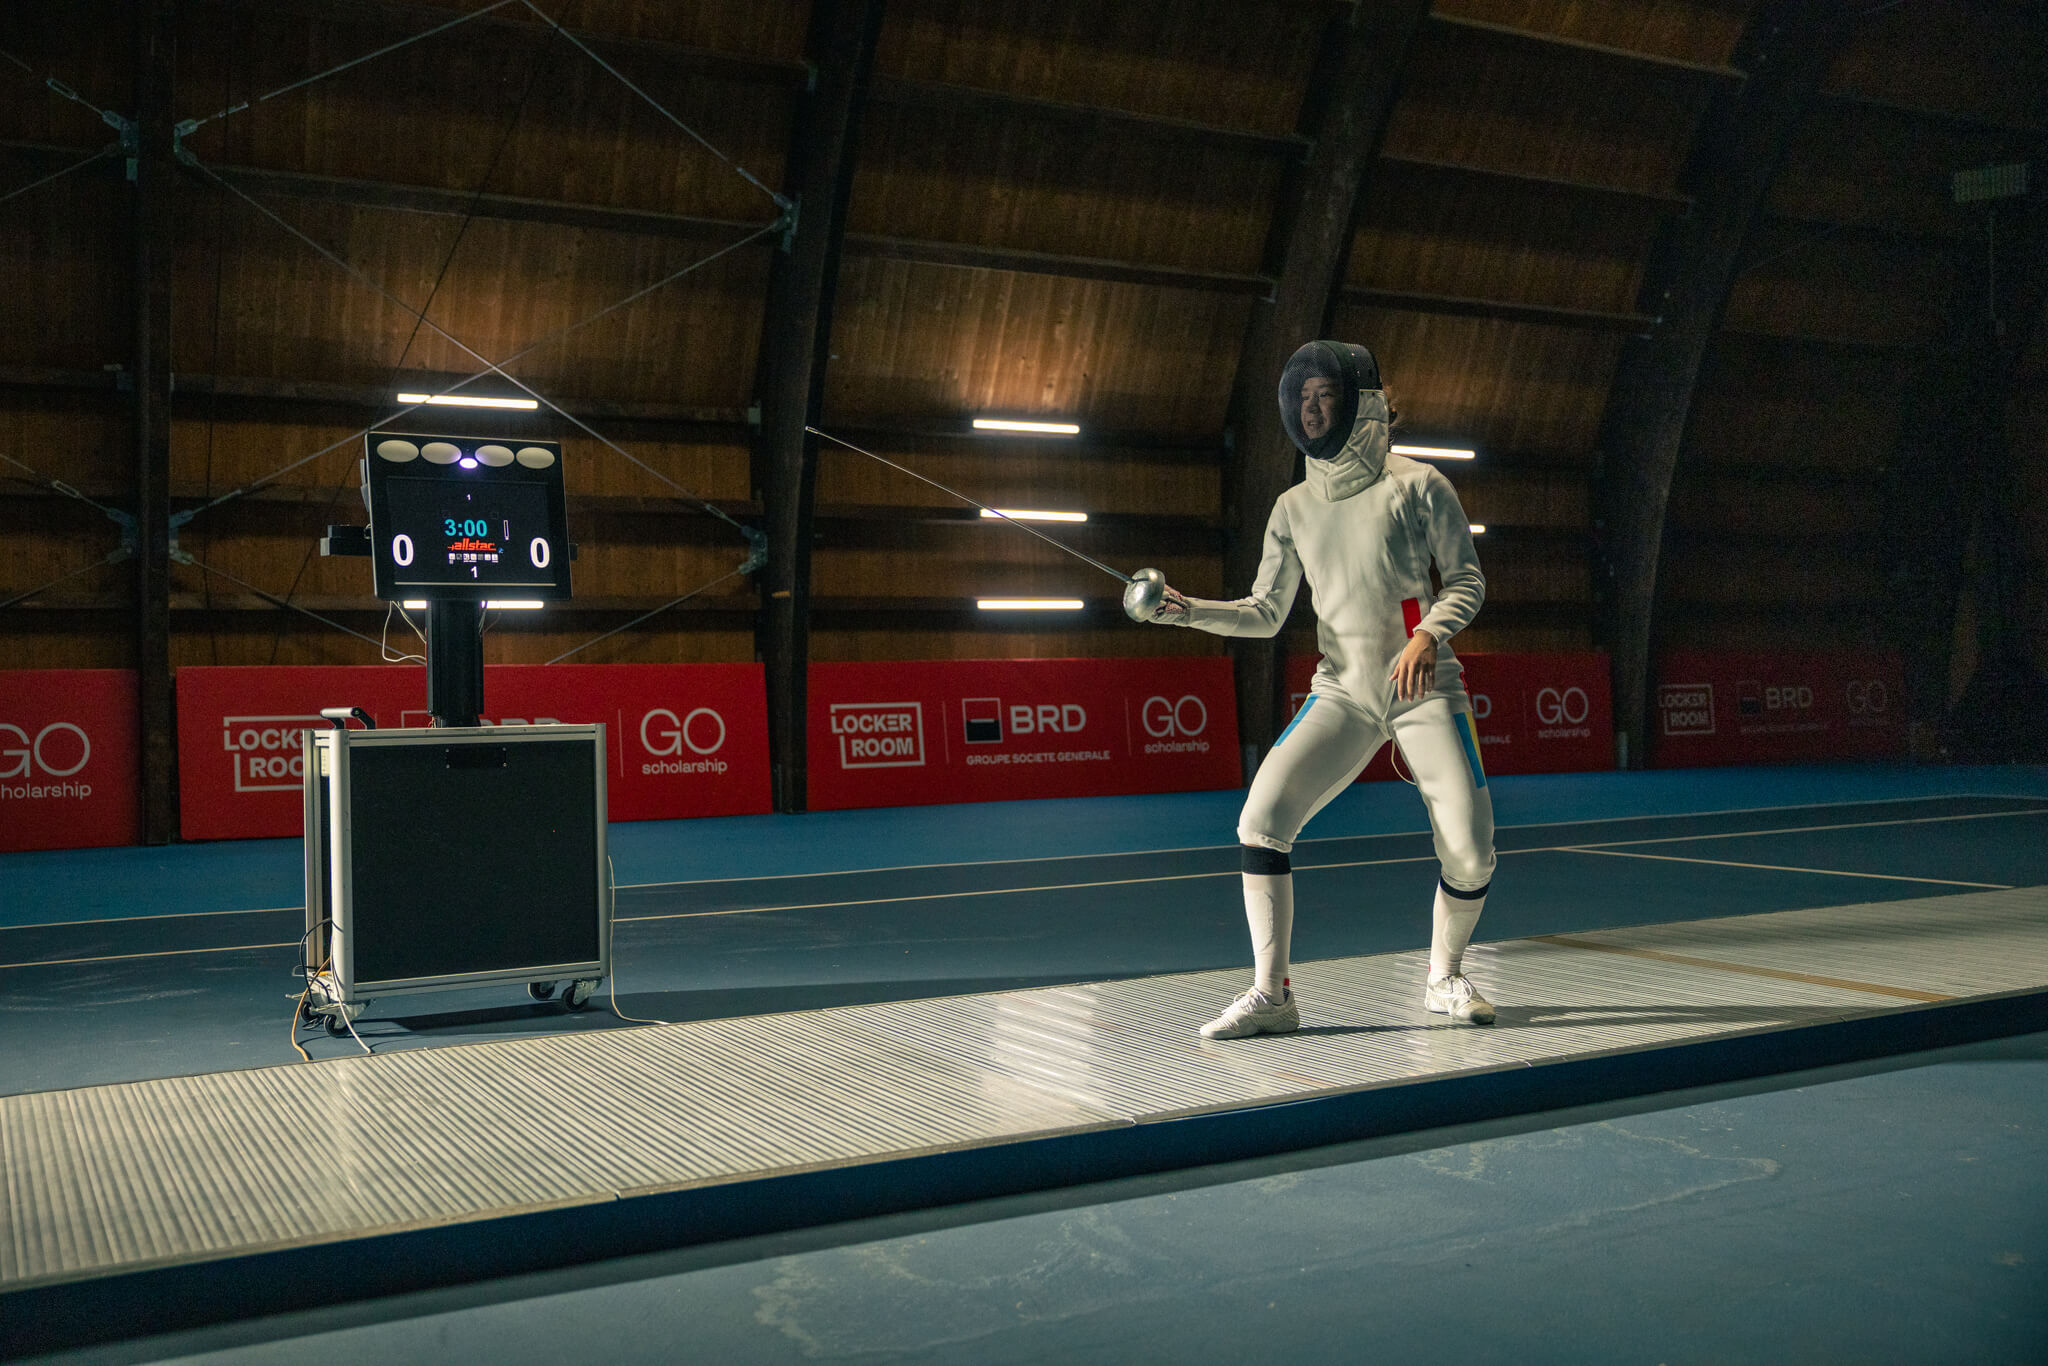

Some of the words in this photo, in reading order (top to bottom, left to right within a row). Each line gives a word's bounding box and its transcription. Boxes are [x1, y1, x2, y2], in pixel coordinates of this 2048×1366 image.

[445, 519, 487, 537] 3:00
[392, 534, 414, 567] 0
[530, 537, 550, 568] 0
[471, 565, 478, 578] 1
[1536, 687, 1589, 725] GO
[1765, 686, 1814, 710] BRD
[831, 713, 912, 734] LOCKER
[1010, 704, 1087, 734] BRD
[1142, 695, 1207, 737] GO
[223, 728, 303, 751] LOCK
[640, 707, 726, 756] GO
[851, 737, 914, 757] ROOM
[966, 754, 1011, 766] GROUPE
[1012, 752, 1056, 764] SOCIETE
[1057, 750, 1110, 762] GENERALE
[1144, 740, 1210, 755] scholarship
[250, 756, 303, 778] ROO
[642, 759, 728, 775] scholarship
[0, 781, 92, 800] holarship
